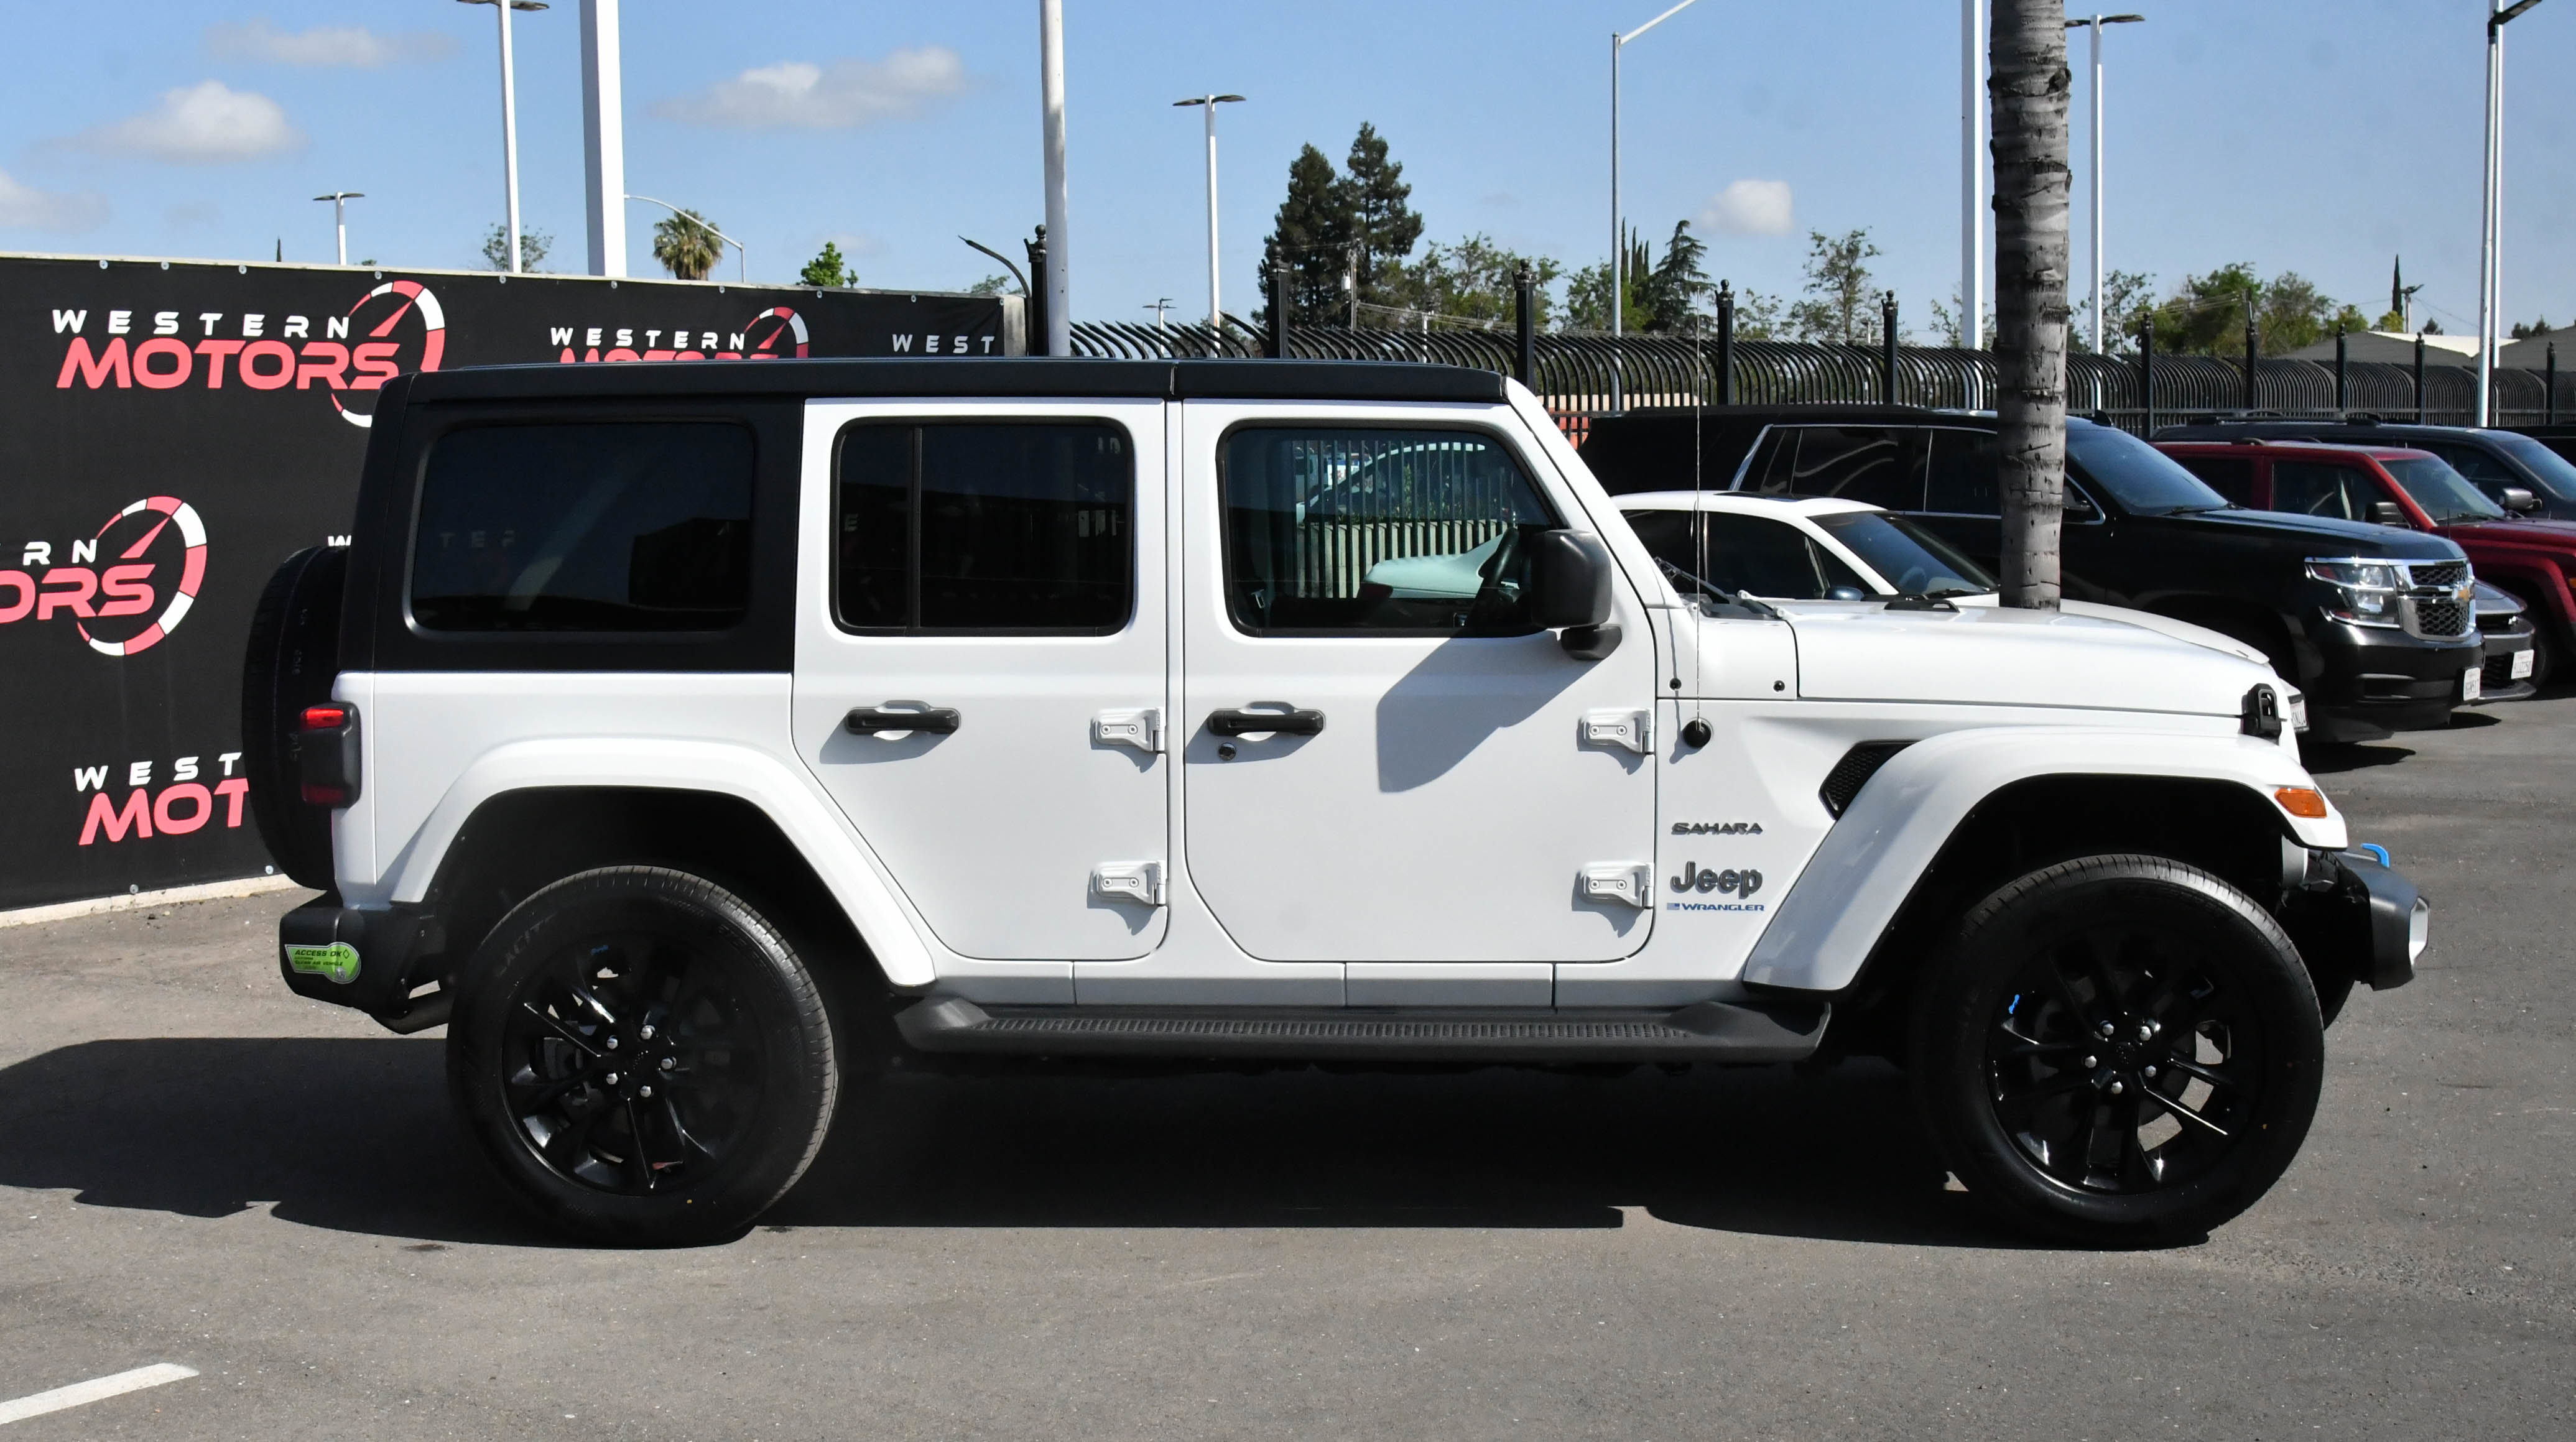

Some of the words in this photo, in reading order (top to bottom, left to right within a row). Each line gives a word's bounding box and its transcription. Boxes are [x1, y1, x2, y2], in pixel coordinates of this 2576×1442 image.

[52, 310, 350, 339] WESTERN
[550, 327, 745, 350] WESTERN
[892, 334, 995, 354] WEST
[56, 336, 401, 390] MOTORS
[74, 752, 242, 792] WEST
[78, 778, 249, 846] MOT
[1671, 822, 1764, 835] SAHARA
[1670, 861, 1763, 900] Jeep
[1681, 903, 1764, 912] WRANGLER
